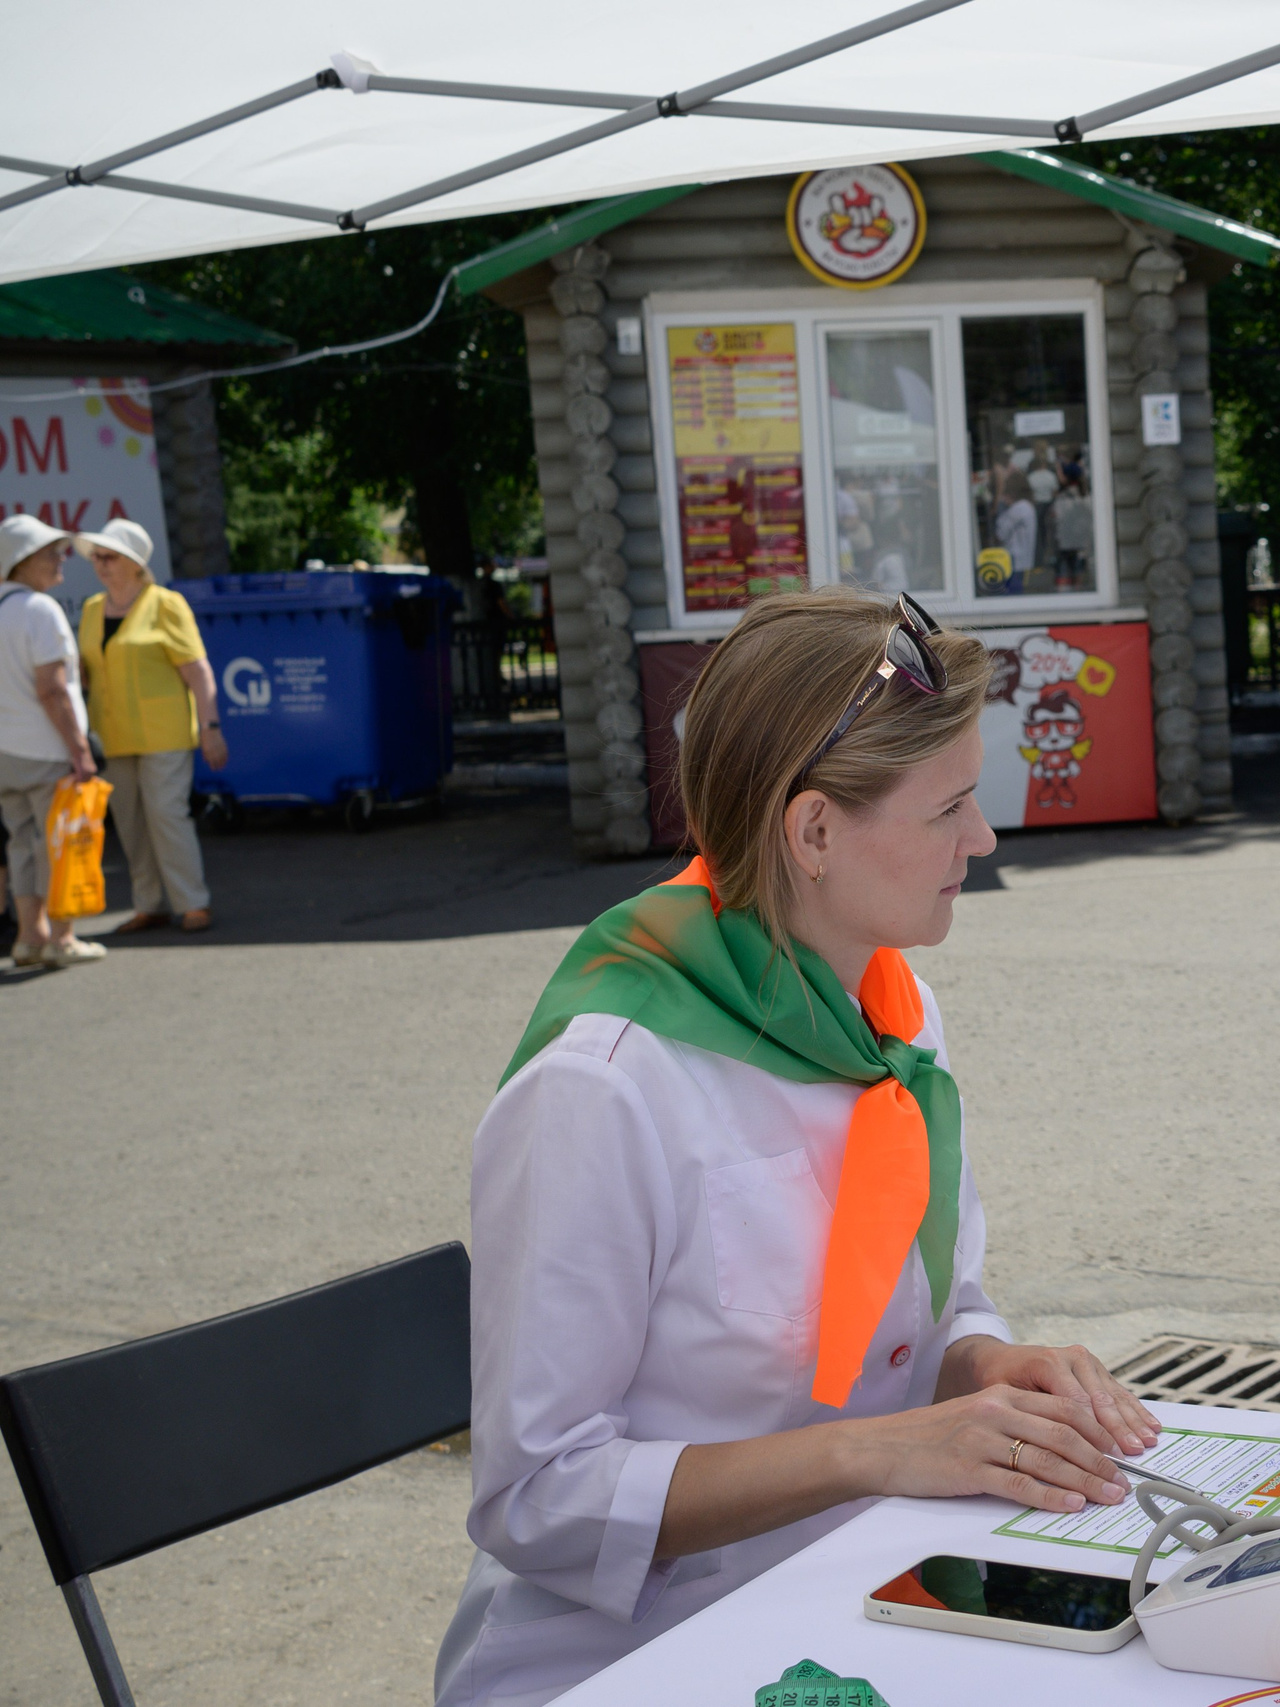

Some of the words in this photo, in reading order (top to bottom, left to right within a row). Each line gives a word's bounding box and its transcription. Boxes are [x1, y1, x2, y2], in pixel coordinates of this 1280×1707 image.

[0, 416, 68, 475] М
[783, 1692, 798, 1707] 20
[804, 1693, 819, 1707] 19
[826, 1693, 841, 1707] 18
[848, 1693, 862, 1706] 17
